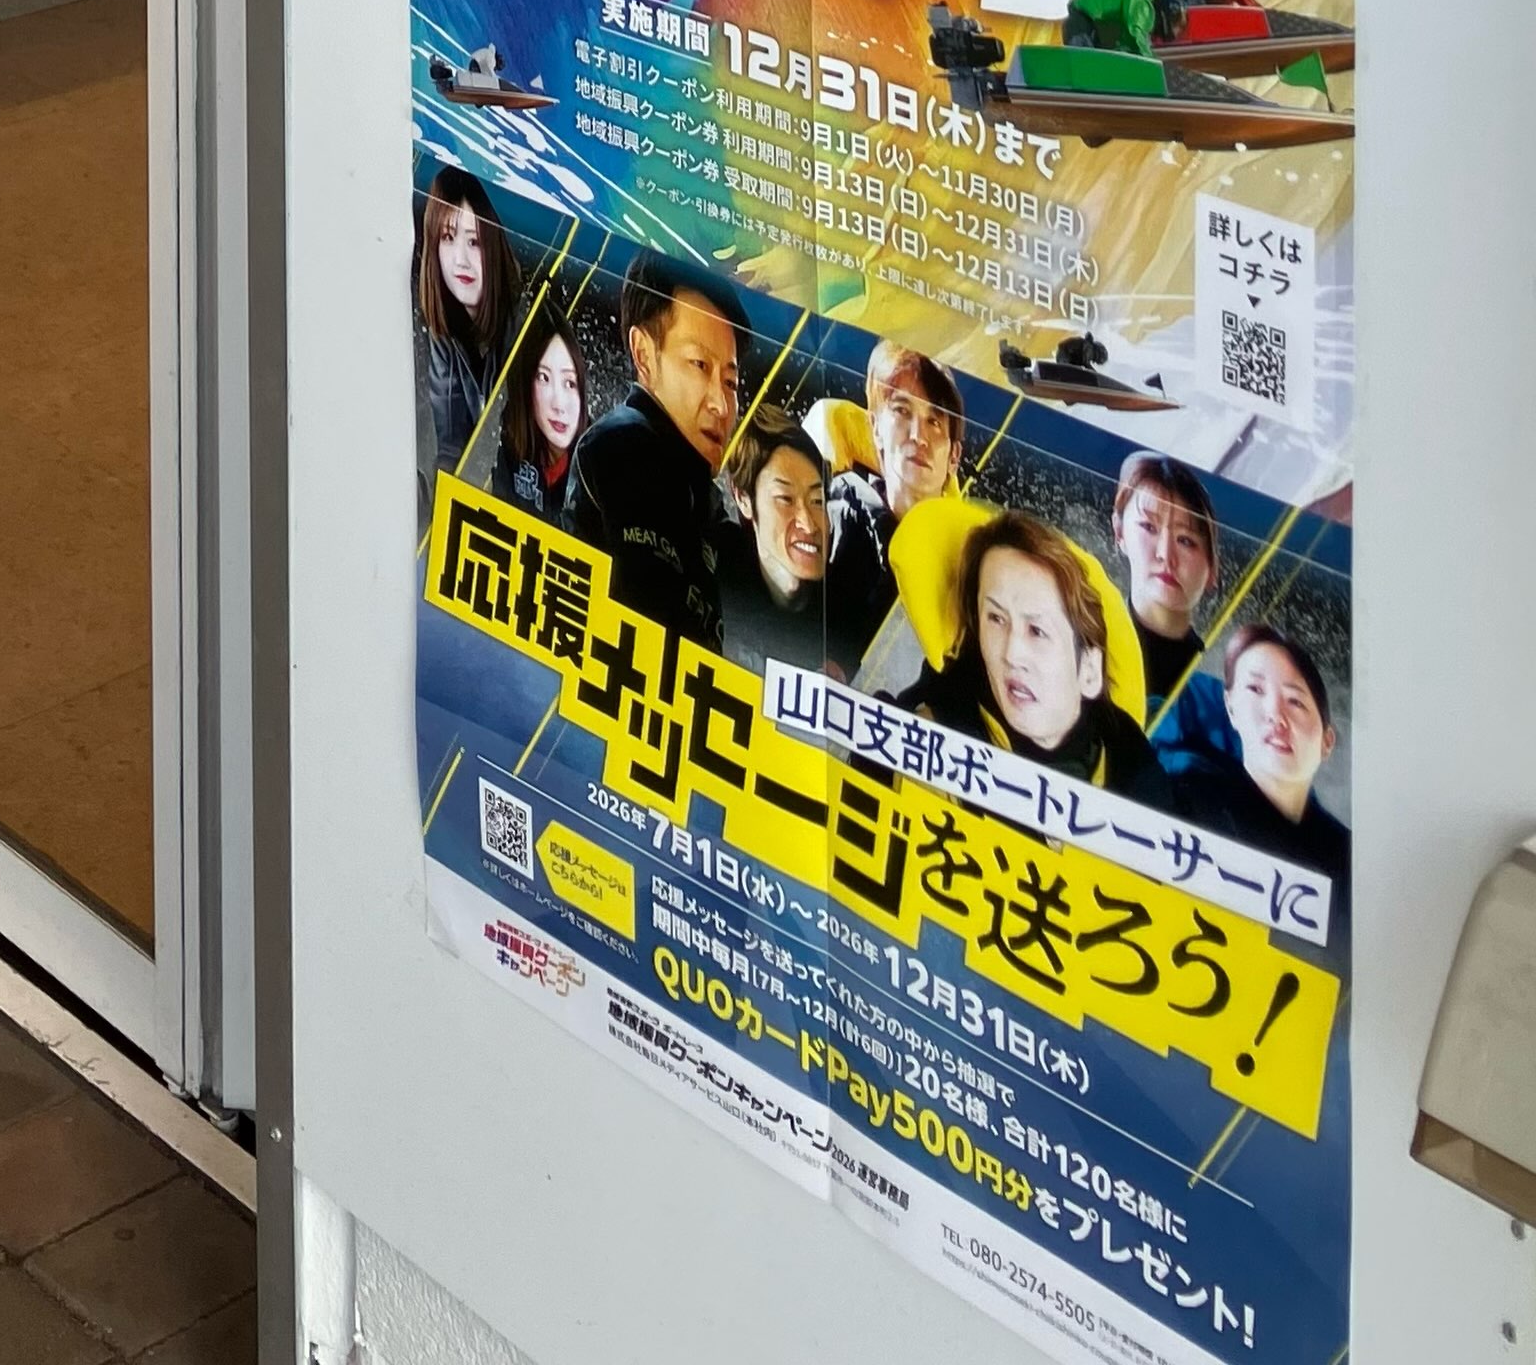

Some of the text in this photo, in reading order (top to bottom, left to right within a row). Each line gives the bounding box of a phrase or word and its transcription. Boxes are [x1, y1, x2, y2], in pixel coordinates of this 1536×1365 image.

[1208, 211, 1302, 265] 詳しくは
[1218, 252, 1291, 296] コチラ
[439, 496, 1302, 1077] 応援メッセージを送ろう!
[775, 673, 1323, 931] 山口支部ボートレーサーに
[651, 873, 1015, 1109] 応援メッセージを送ってくれた方の中から抽選で
